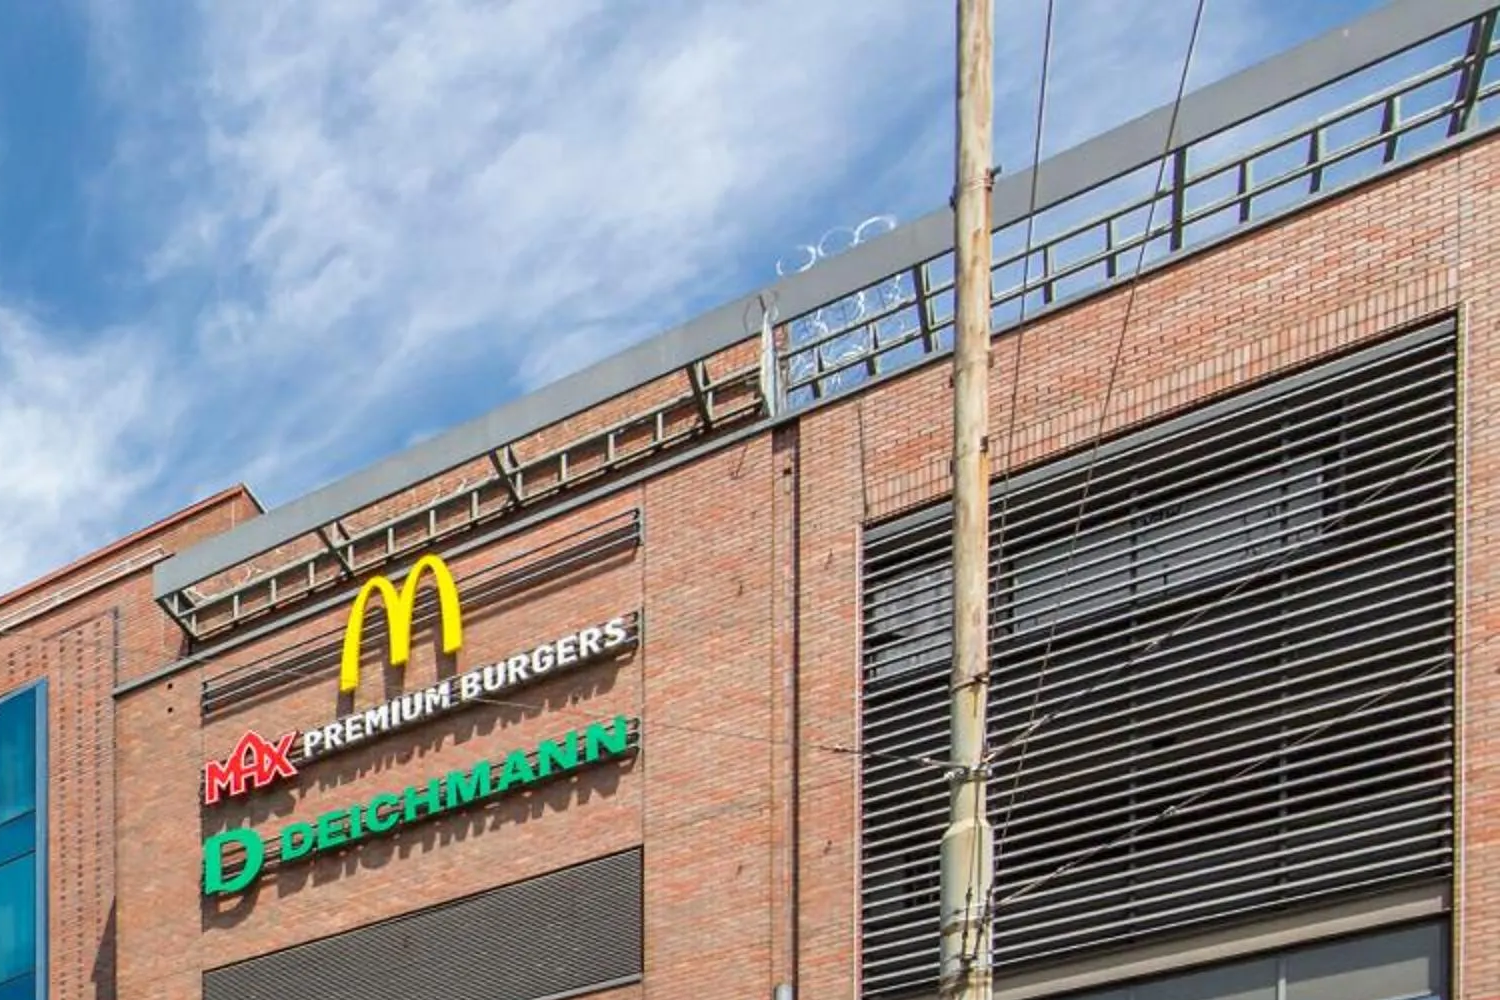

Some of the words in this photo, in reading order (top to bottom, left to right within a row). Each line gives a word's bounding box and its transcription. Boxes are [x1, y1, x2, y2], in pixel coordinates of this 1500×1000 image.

[205, 729, 299, 805] MAX
[303, 684, 452, 758] PREMIUM
[461, 616, 628, 702] BURGERS
[202, 826, 265, 896] D
[279, 714, 629, 861] DEICHMANN
